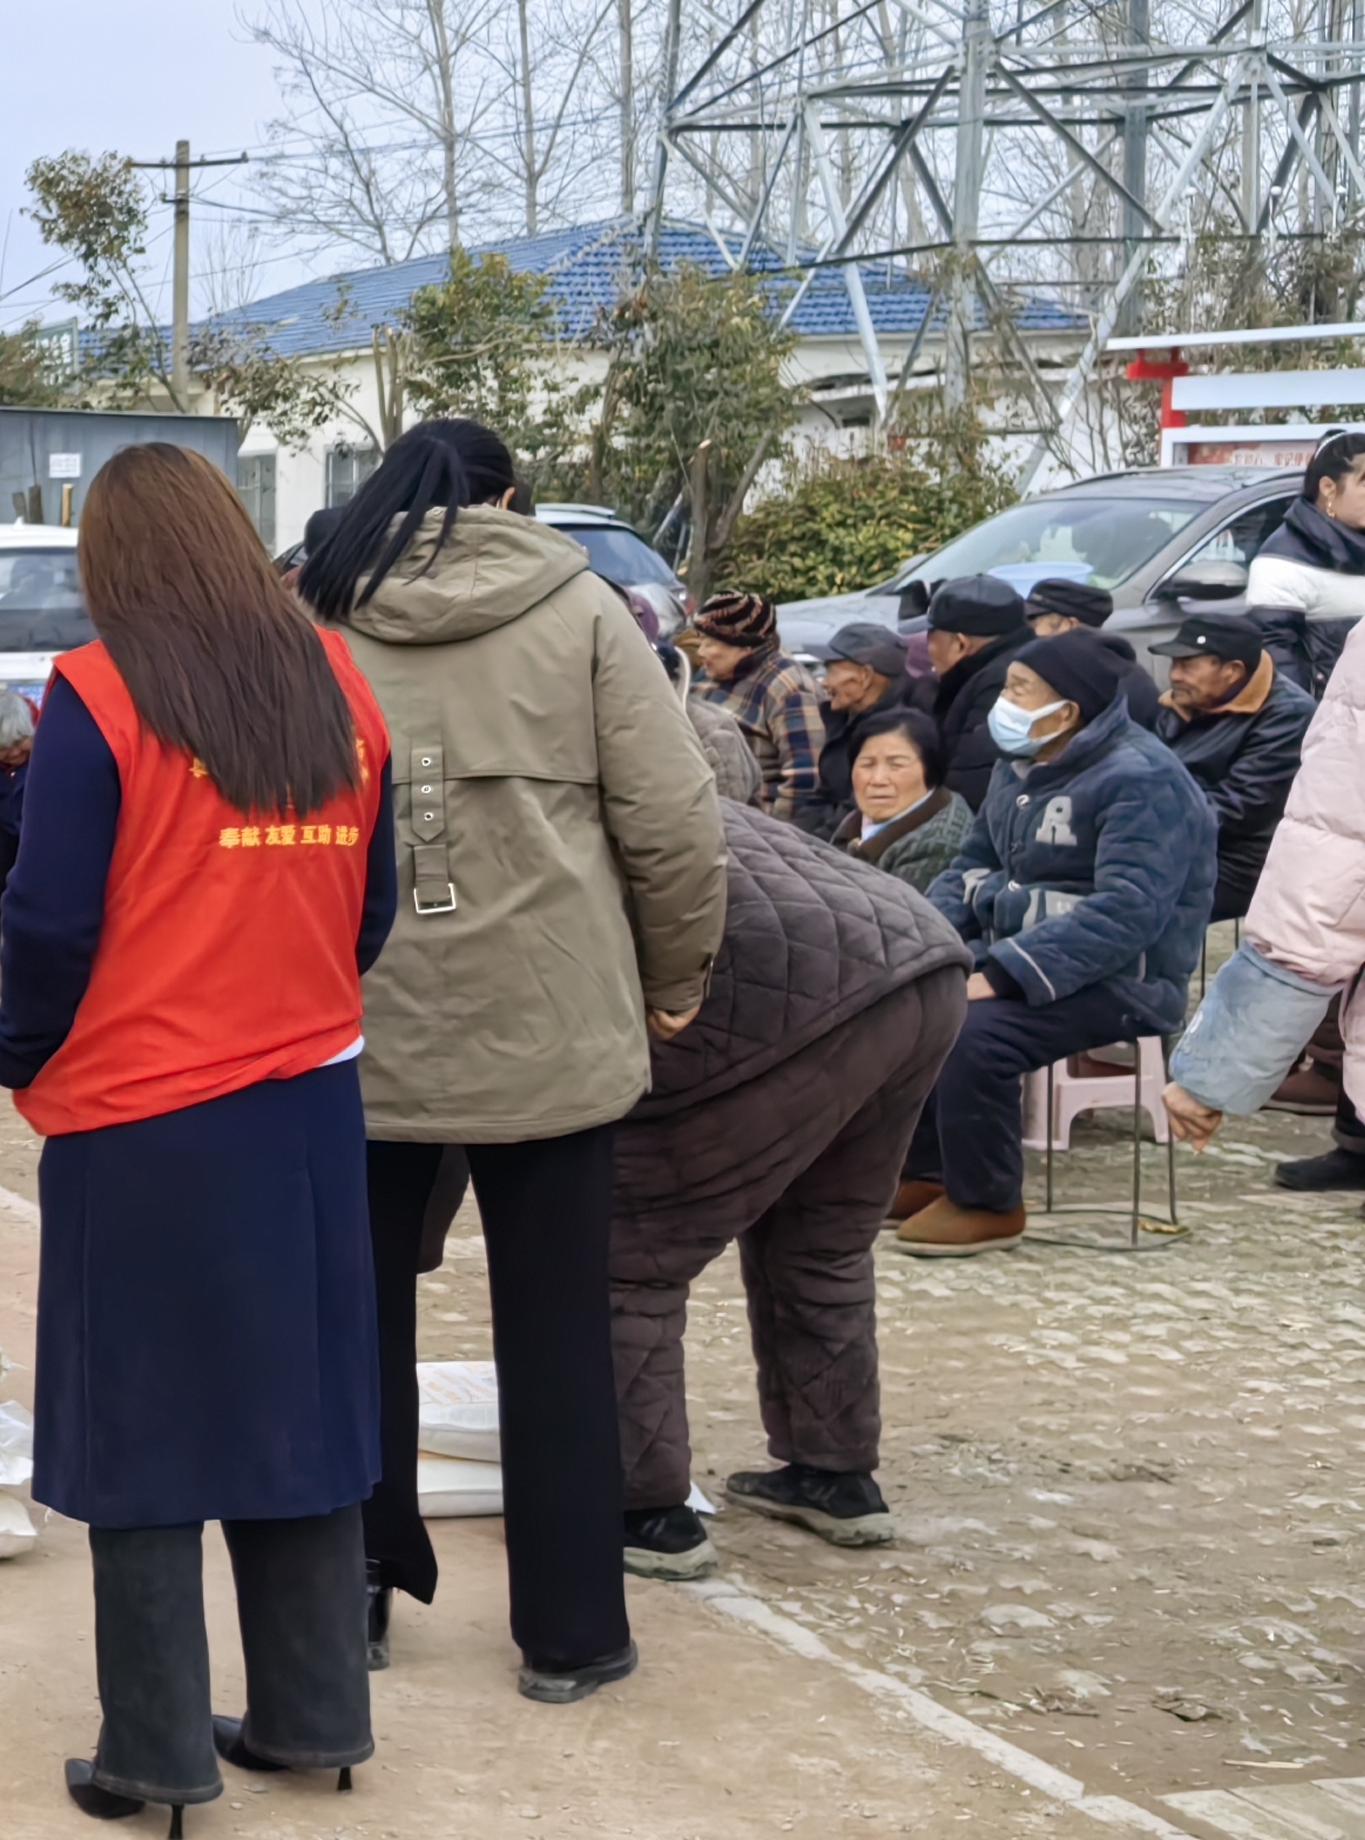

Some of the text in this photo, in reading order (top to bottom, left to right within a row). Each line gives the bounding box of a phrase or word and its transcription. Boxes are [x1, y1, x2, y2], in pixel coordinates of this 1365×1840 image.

[219, 824, 360, 849] 奉献 友爱 互助 进步
